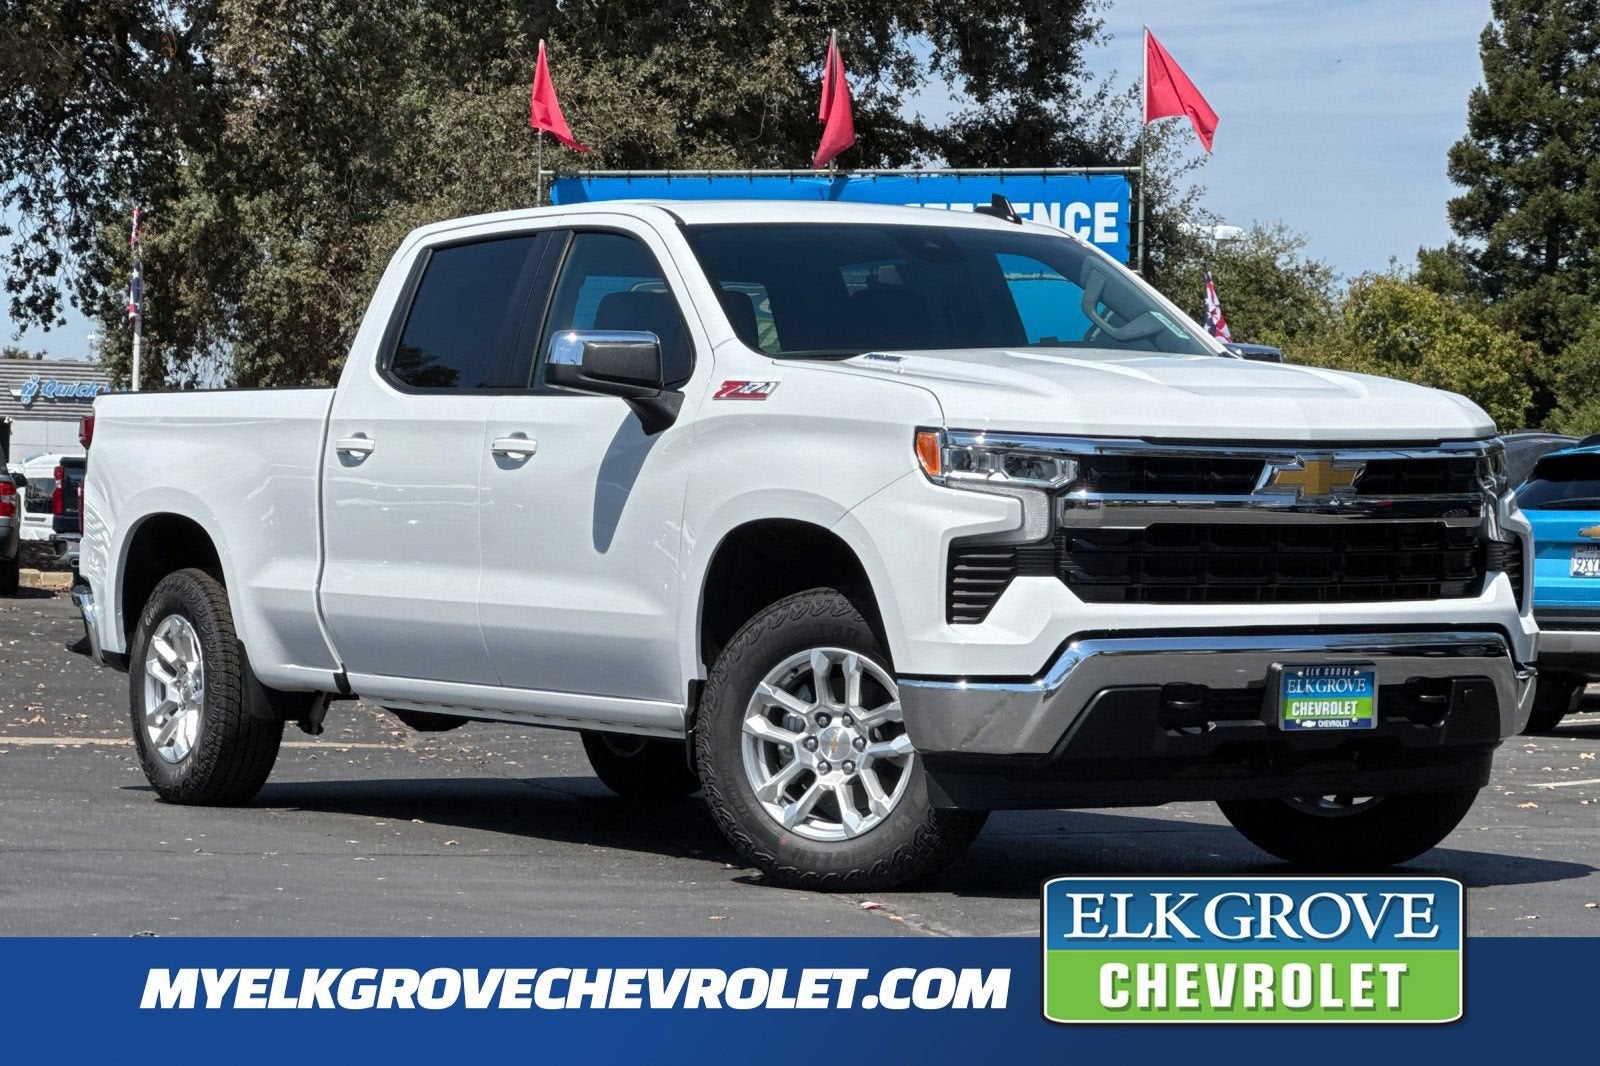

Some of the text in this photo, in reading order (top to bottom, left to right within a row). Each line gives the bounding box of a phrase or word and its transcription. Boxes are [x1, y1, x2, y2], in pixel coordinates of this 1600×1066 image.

[41, 380, 99, 398] Quick
[1306, 667, 1352, 676] ELK GROVE
[1287, 678, 1366, 694] ELK GROVE
[1292, 701, 1358, 716] CHEVROLET
[1317, 720, 1350, 728] CHEVROLET
